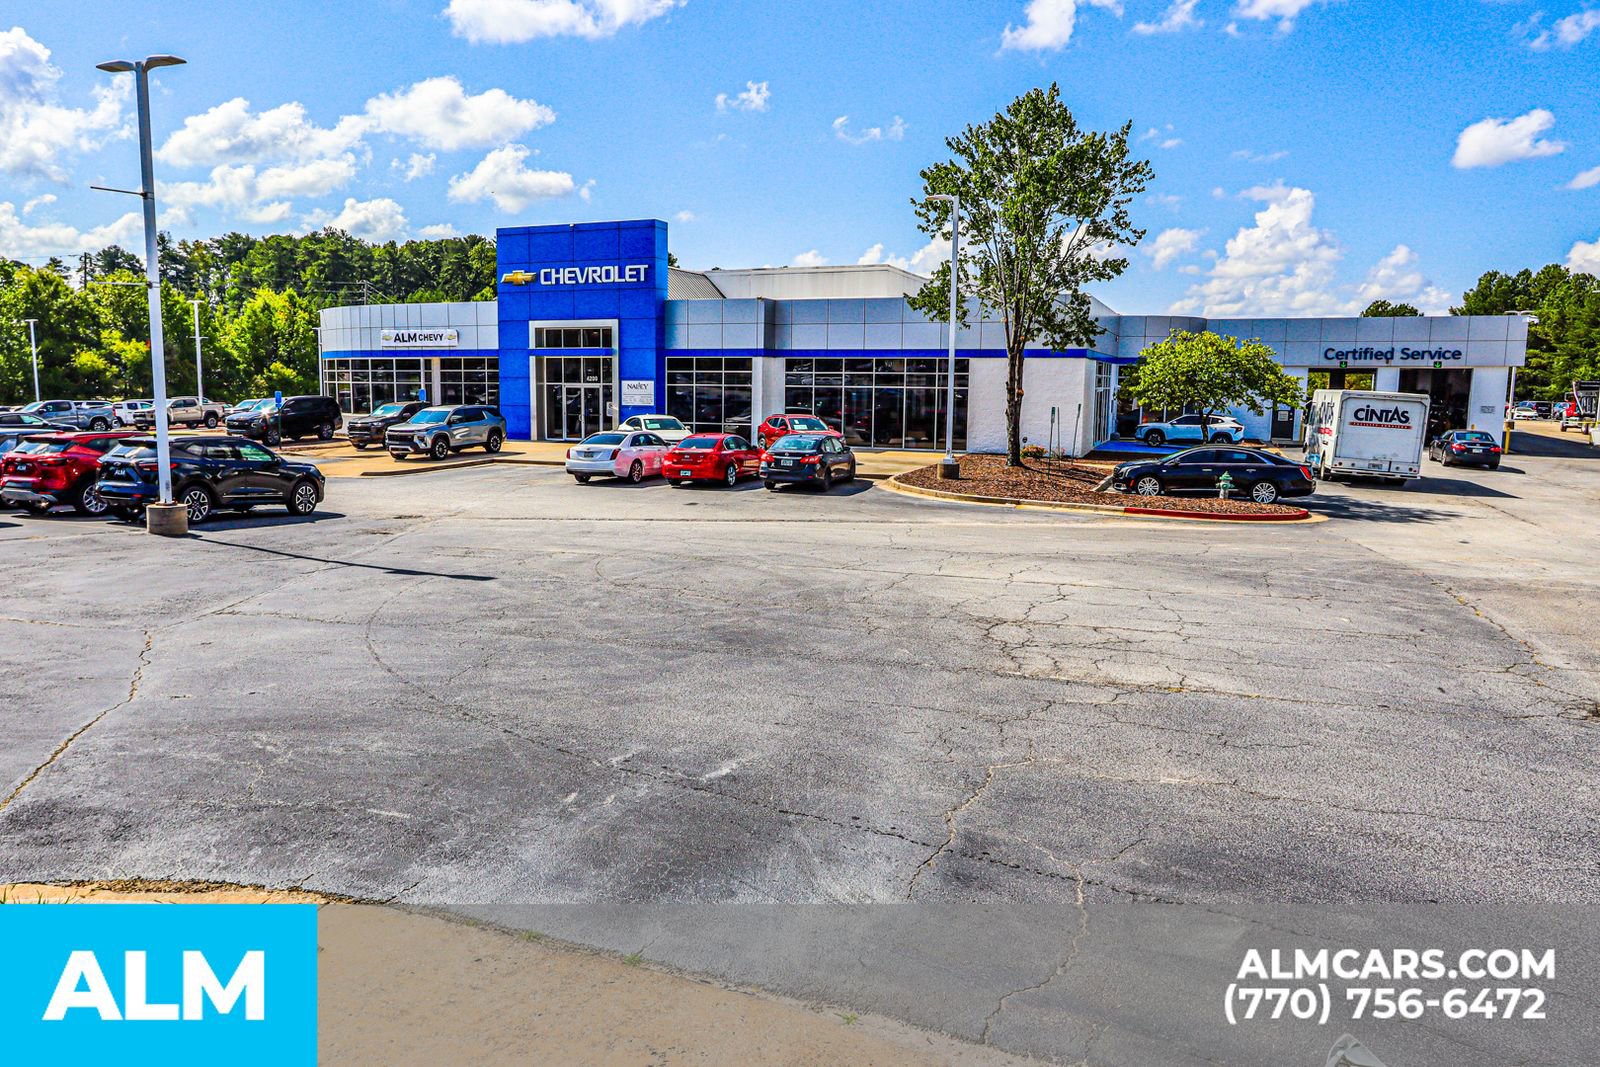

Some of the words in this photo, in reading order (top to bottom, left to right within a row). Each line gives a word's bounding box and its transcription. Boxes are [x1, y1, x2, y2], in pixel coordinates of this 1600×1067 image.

[540, 264, 649, 285] CHEVROLET
[394, 333, 417, 343] ALM
[418, 333, 444, 342] CHEVY
[1324, 347, 1395, 361] Certified
[1400, 347, 1463, 361] Service
